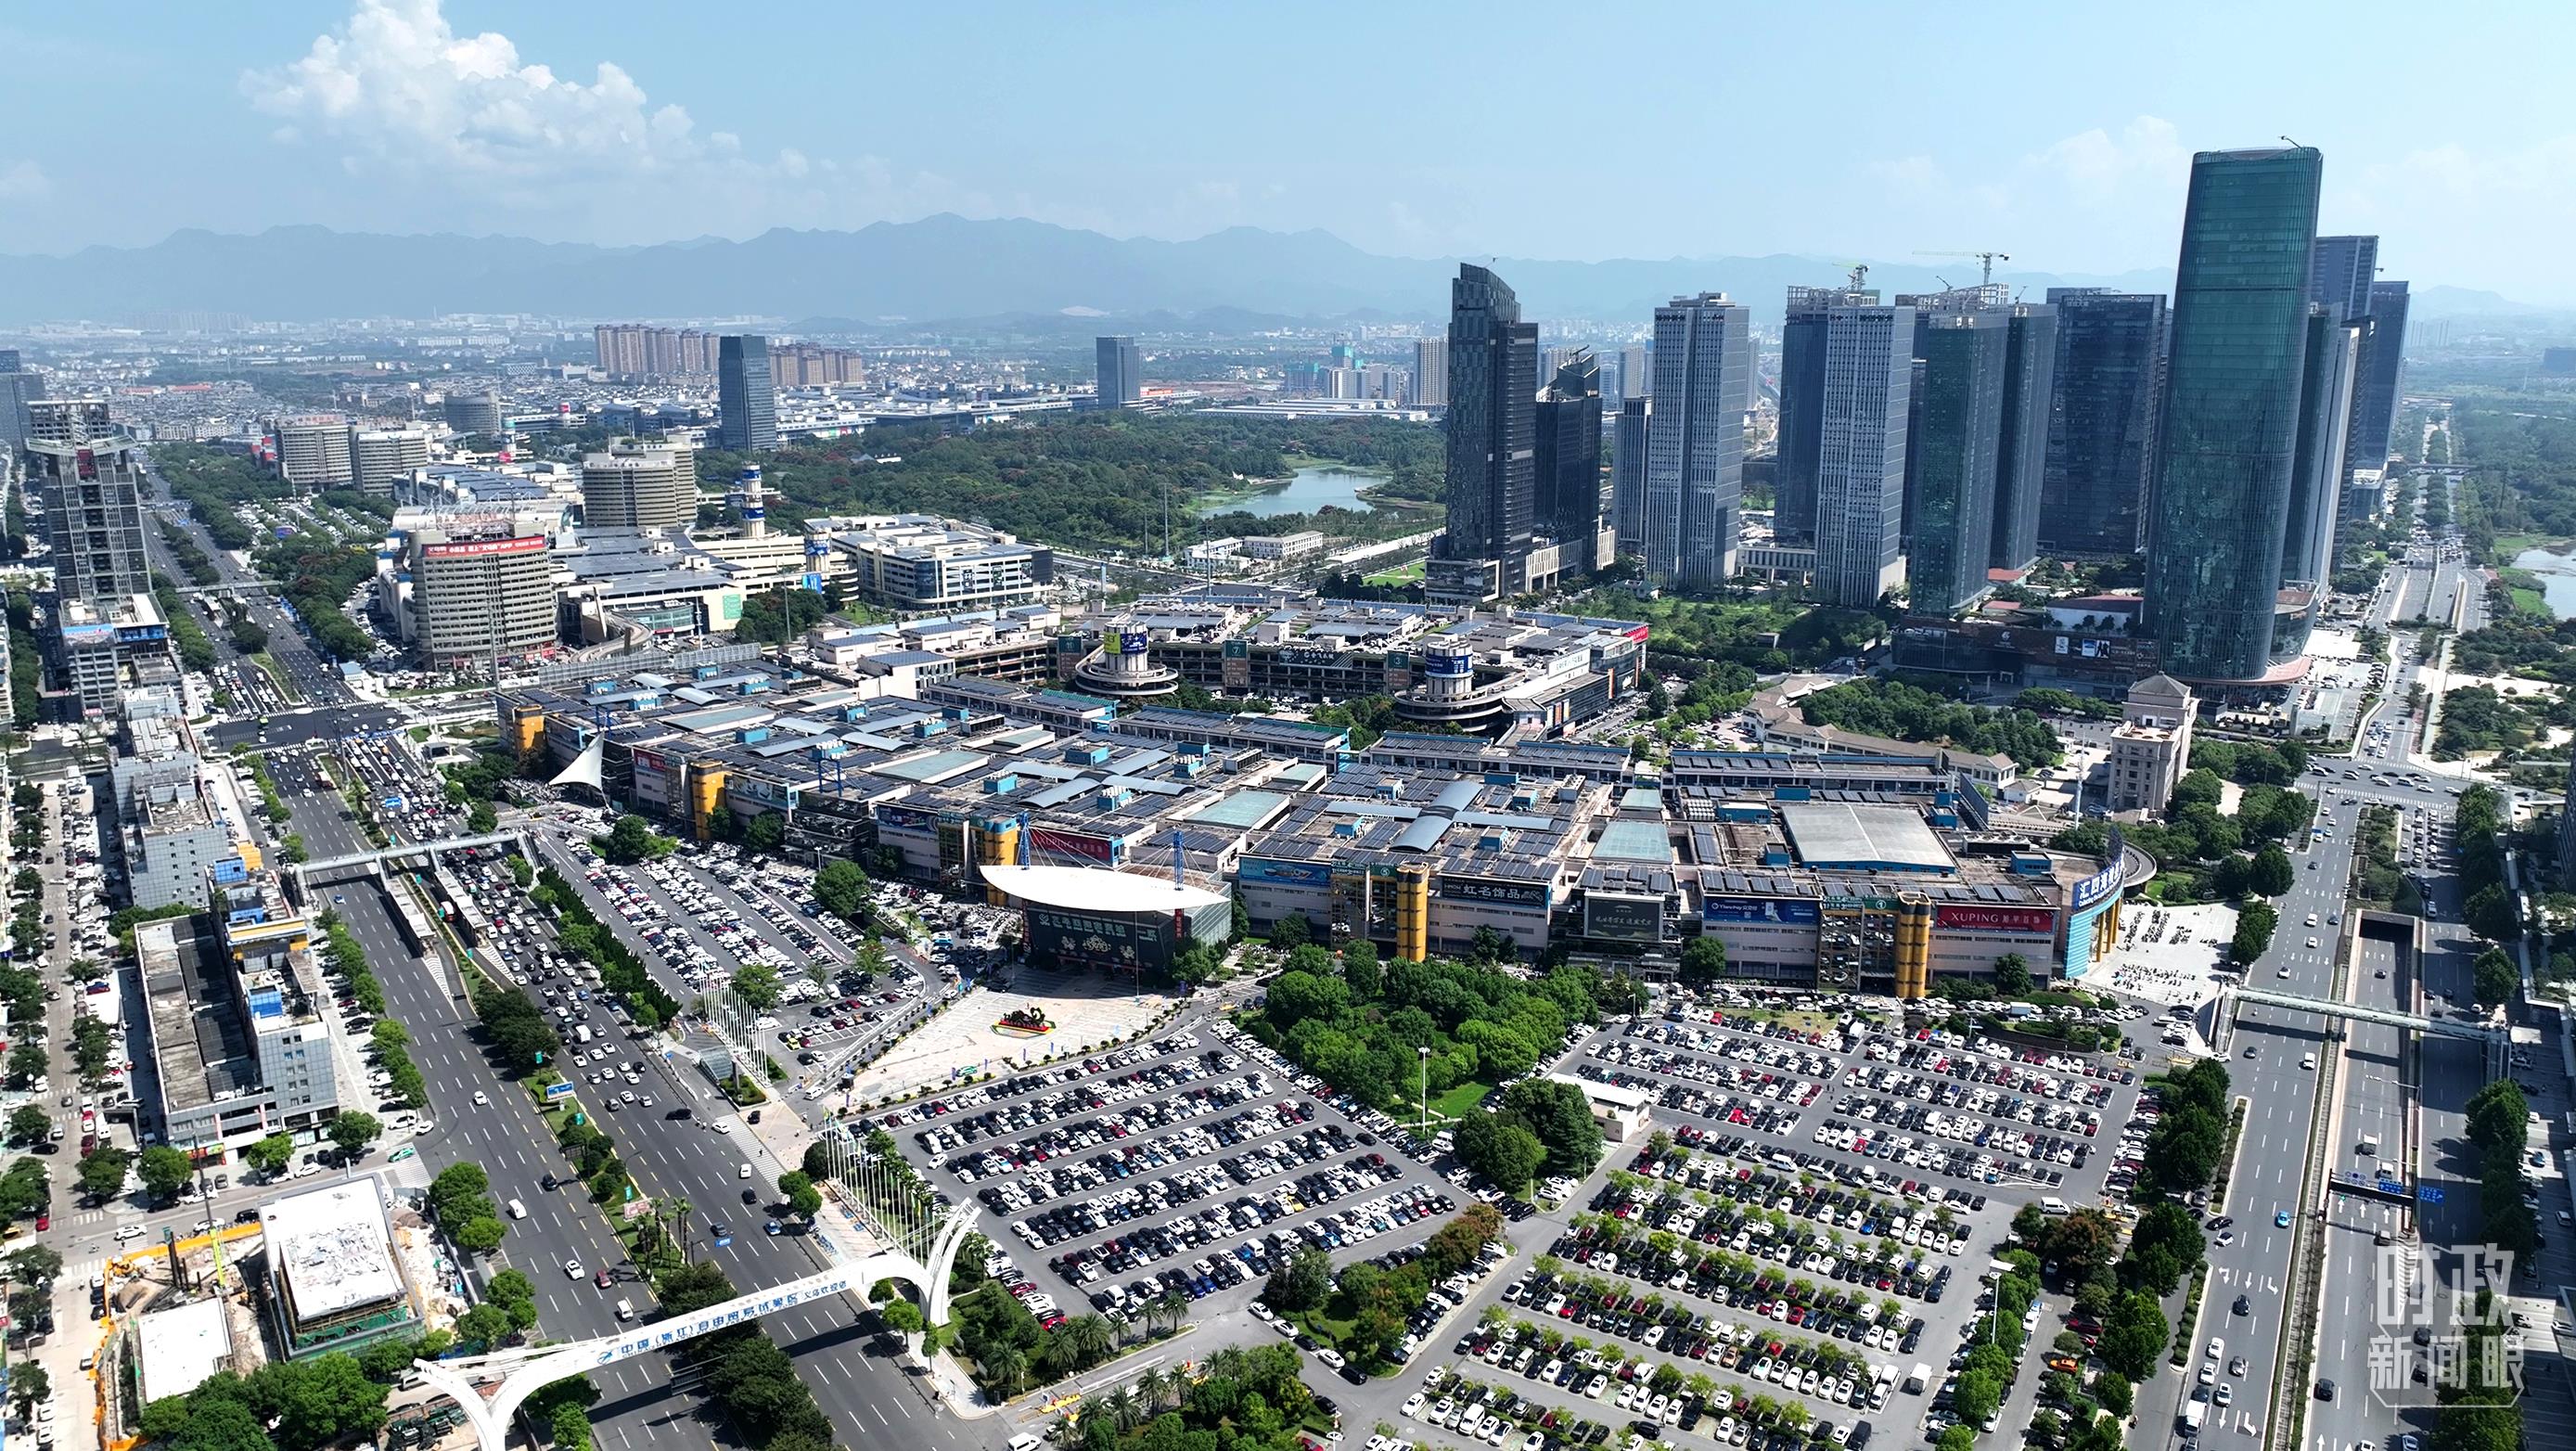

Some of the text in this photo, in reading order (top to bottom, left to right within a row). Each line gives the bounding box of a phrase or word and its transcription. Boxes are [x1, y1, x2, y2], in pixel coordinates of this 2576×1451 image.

[1463, 884, 1520, 899] 虹名饰品
[1952, 912, 1999, 922] XUPING
